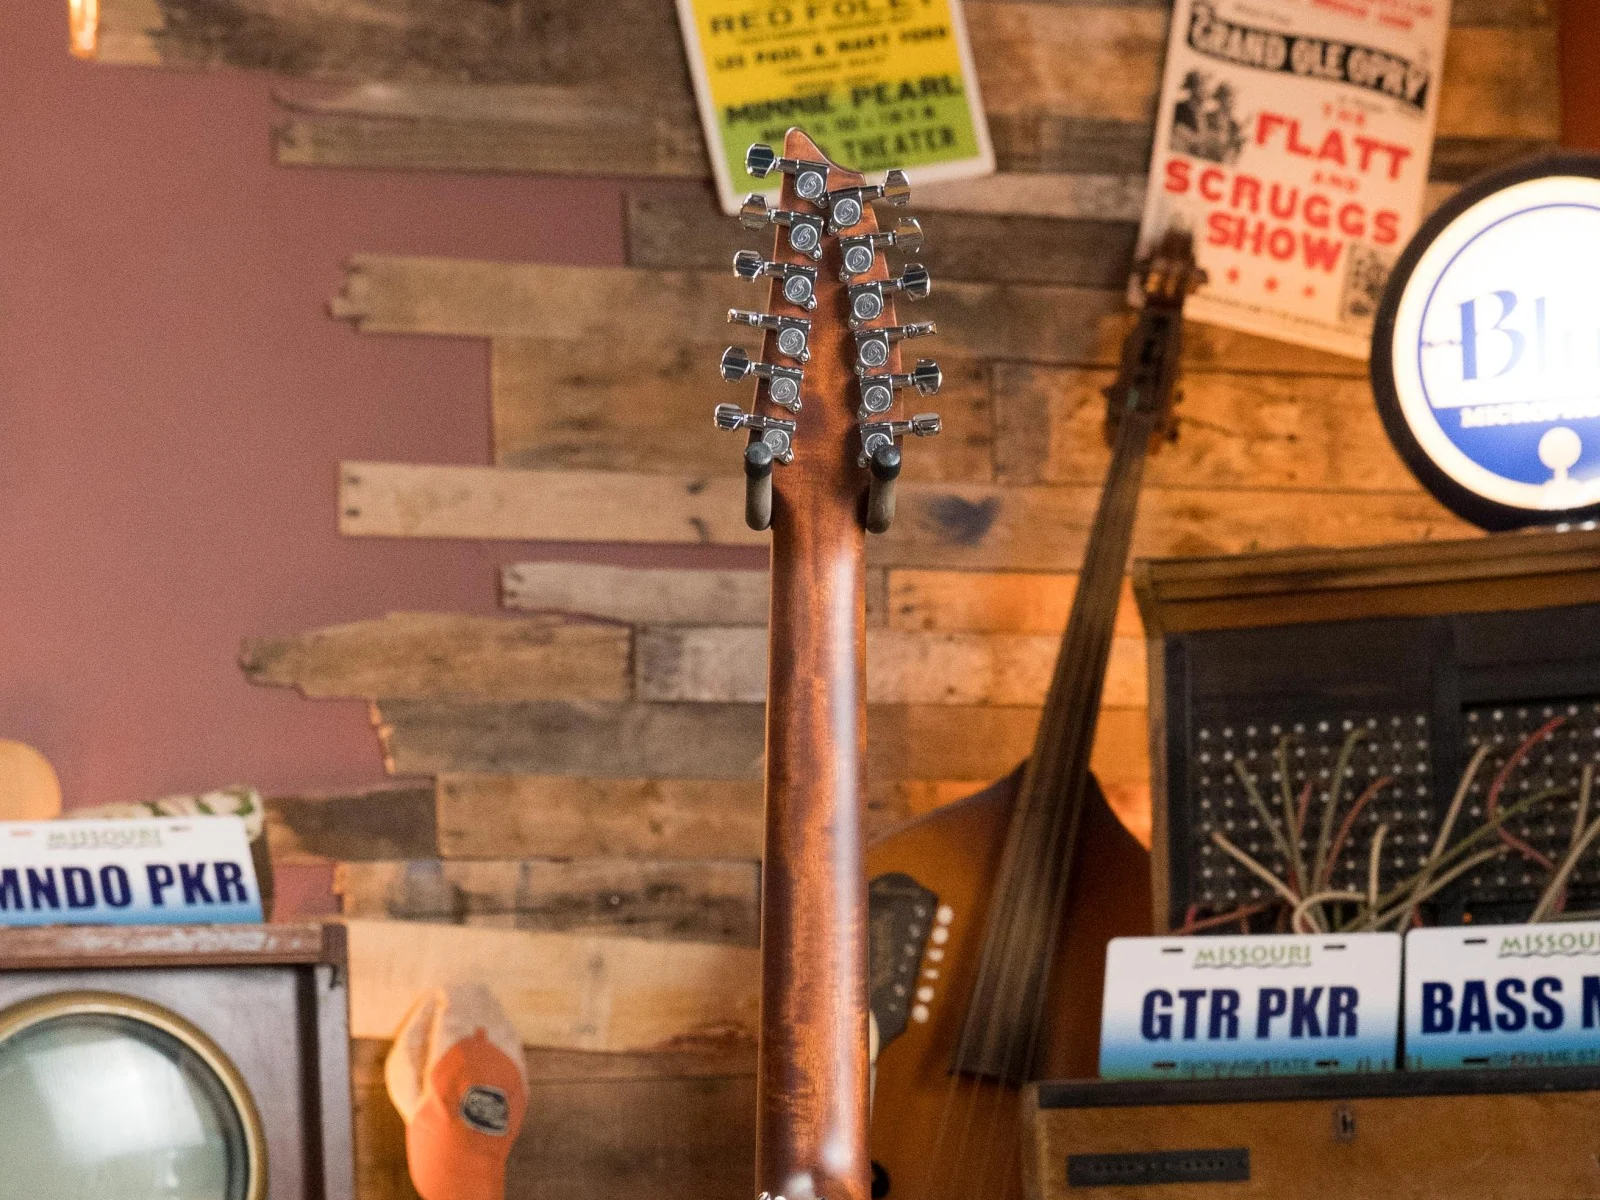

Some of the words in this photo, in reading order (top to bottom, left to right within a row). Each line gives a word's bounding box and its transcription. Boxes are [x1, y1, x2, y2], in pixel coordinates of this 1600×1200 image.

[1190, 8, 1287, 70] GRAND
[1292, 38, 1344, 80] OLE
[1346, 46, 1429, 105] OPRY
[725, 91, 832, 125] MINNIE
[851, 75, 963, 108] PEARL
[844, 126, 955, 159] THEATER
[1254, 110, 1412, 181] FLATT
[1163, 157, 1401, 246] SCRUGGS
[1206, 212, 1344, 274] SHOW
[146, 860, 249, 907] PKR
[1195, 943, 1313, 964] MISSOURI
[1501, 931, 1600, 951] MISSOU
[1140, 987, 1241, 1043] GTR
[1256, 984, 1360, 1041] PKR
[1421, 976, 1565, 1035] BASS
